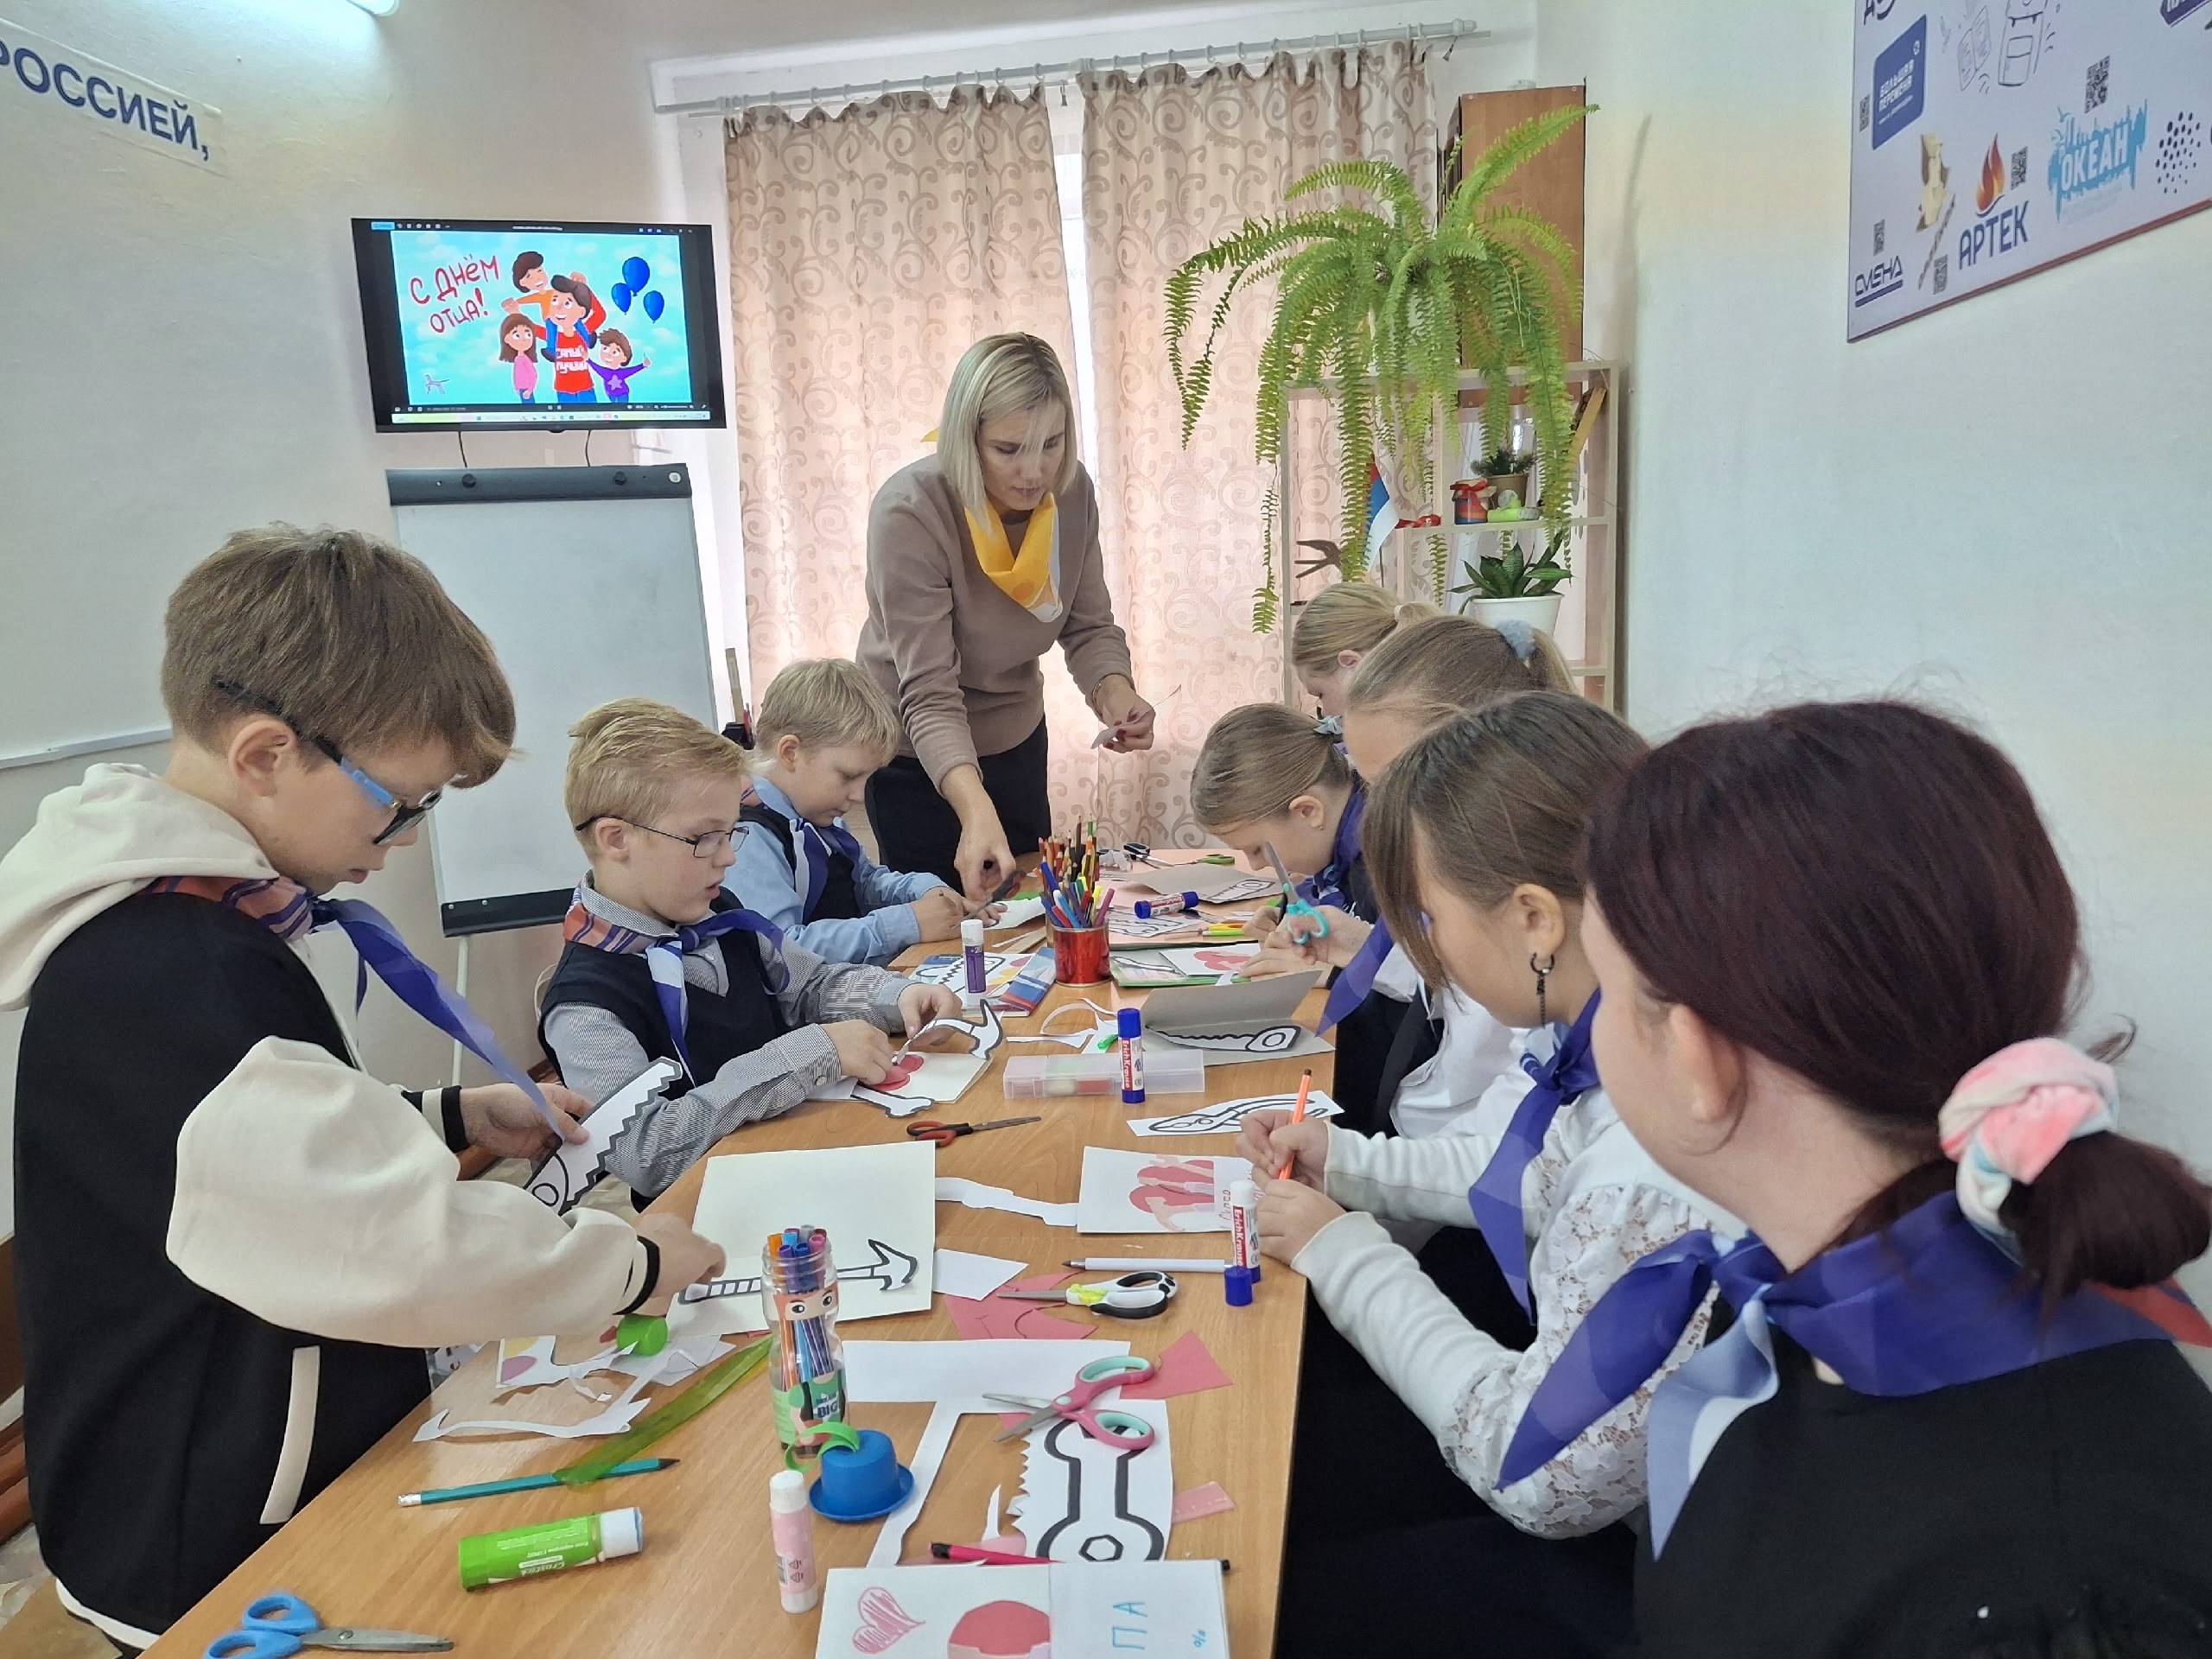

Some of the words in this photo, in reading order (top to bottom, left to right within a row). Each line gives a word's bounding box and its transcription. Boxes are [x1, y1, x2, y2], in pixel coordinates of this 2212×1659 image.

[2060, 120, 2129, 192] ОКЕАН
[1959, 200, 2029, 270] АРТЕК
[410, 277, 430, 304] С
[429, 287, 489, 333] ОТЦА!
[1122, 1039, 1131, 1089] ErichKrause
